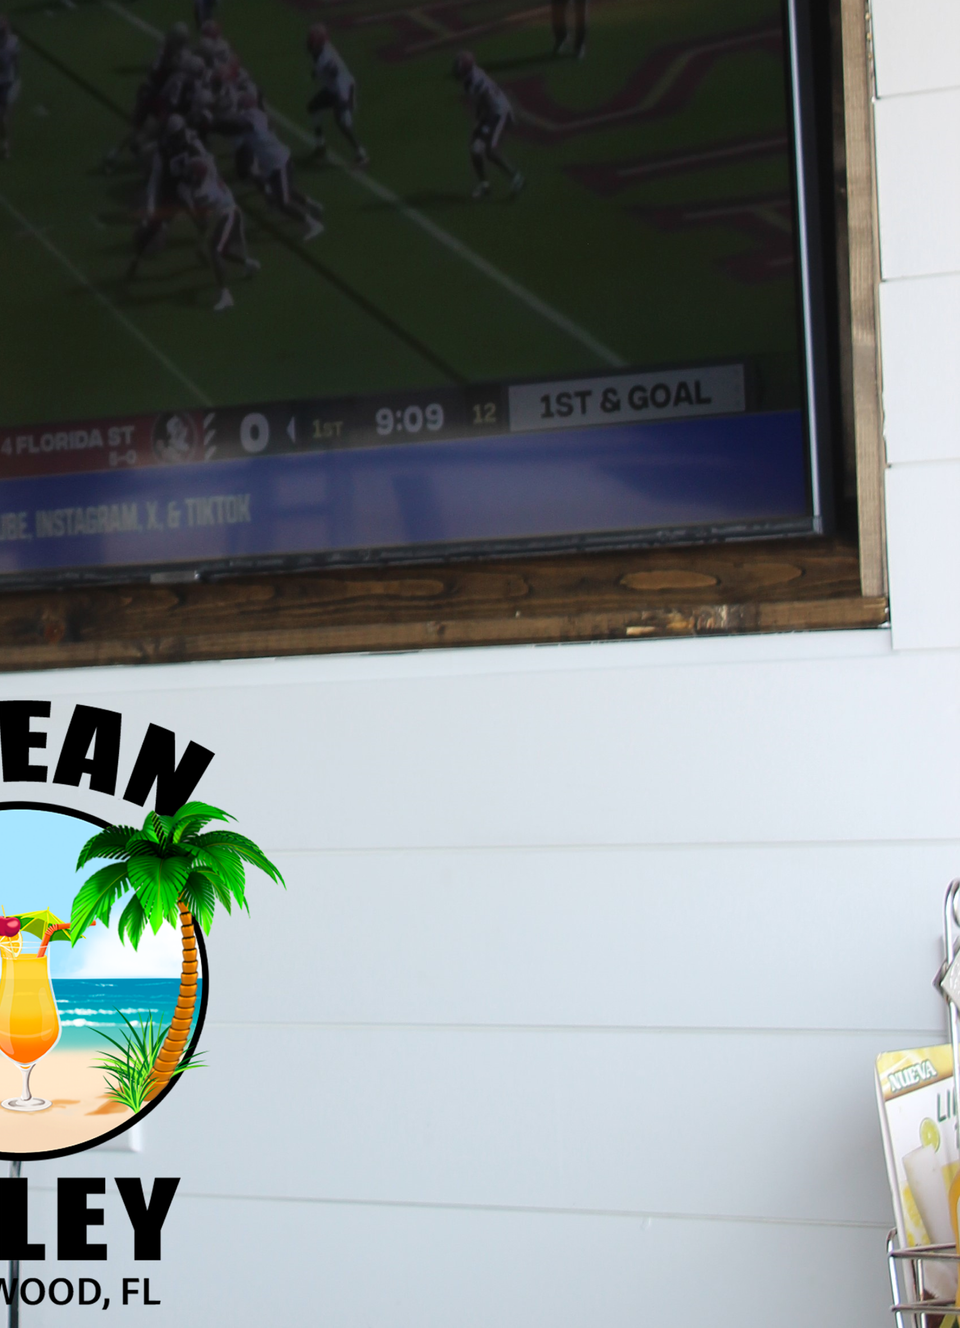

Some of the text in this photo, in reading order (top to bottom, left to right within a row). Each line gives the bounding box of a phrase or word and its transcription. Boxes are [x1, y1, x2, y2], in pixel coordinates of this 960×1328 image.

[472, 402, 497, 423] 12
[540, 379, 712, 419] 1ST & GOAL
[239, 412, 270, 453] 0
[375, 402, 444, 436] 9:09
[15, 428, 103, 455] FLORIDA
[107, 425, 136, 447] ST
[35, 501, 144, 538] INSTAGRAM,
[184, 493, 252, 527] TIKTOK
[888, 1059, 938, 1093] NUEVA
